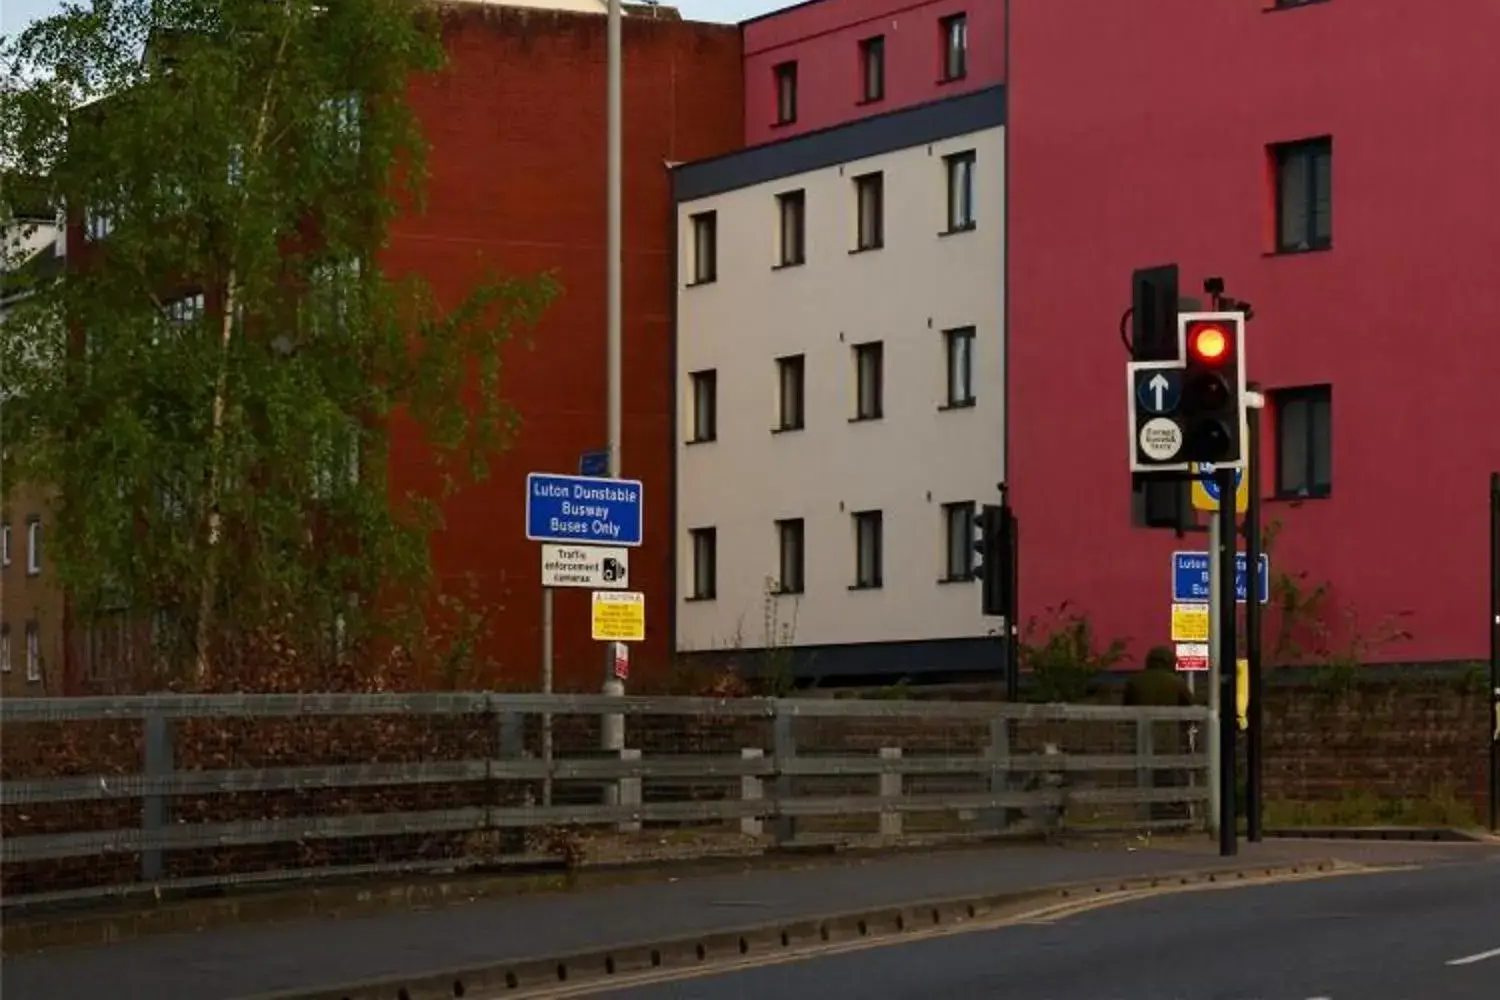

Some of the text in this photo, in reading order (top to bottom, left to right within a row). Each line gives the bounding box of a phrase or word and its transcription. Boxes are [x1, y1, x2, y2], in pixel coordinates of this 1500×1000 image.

[534, 483, 637, 503] Luton Dunstable
[562, 501, 609, 520] Busway
[551, 518, 621, 537] Buses Only
